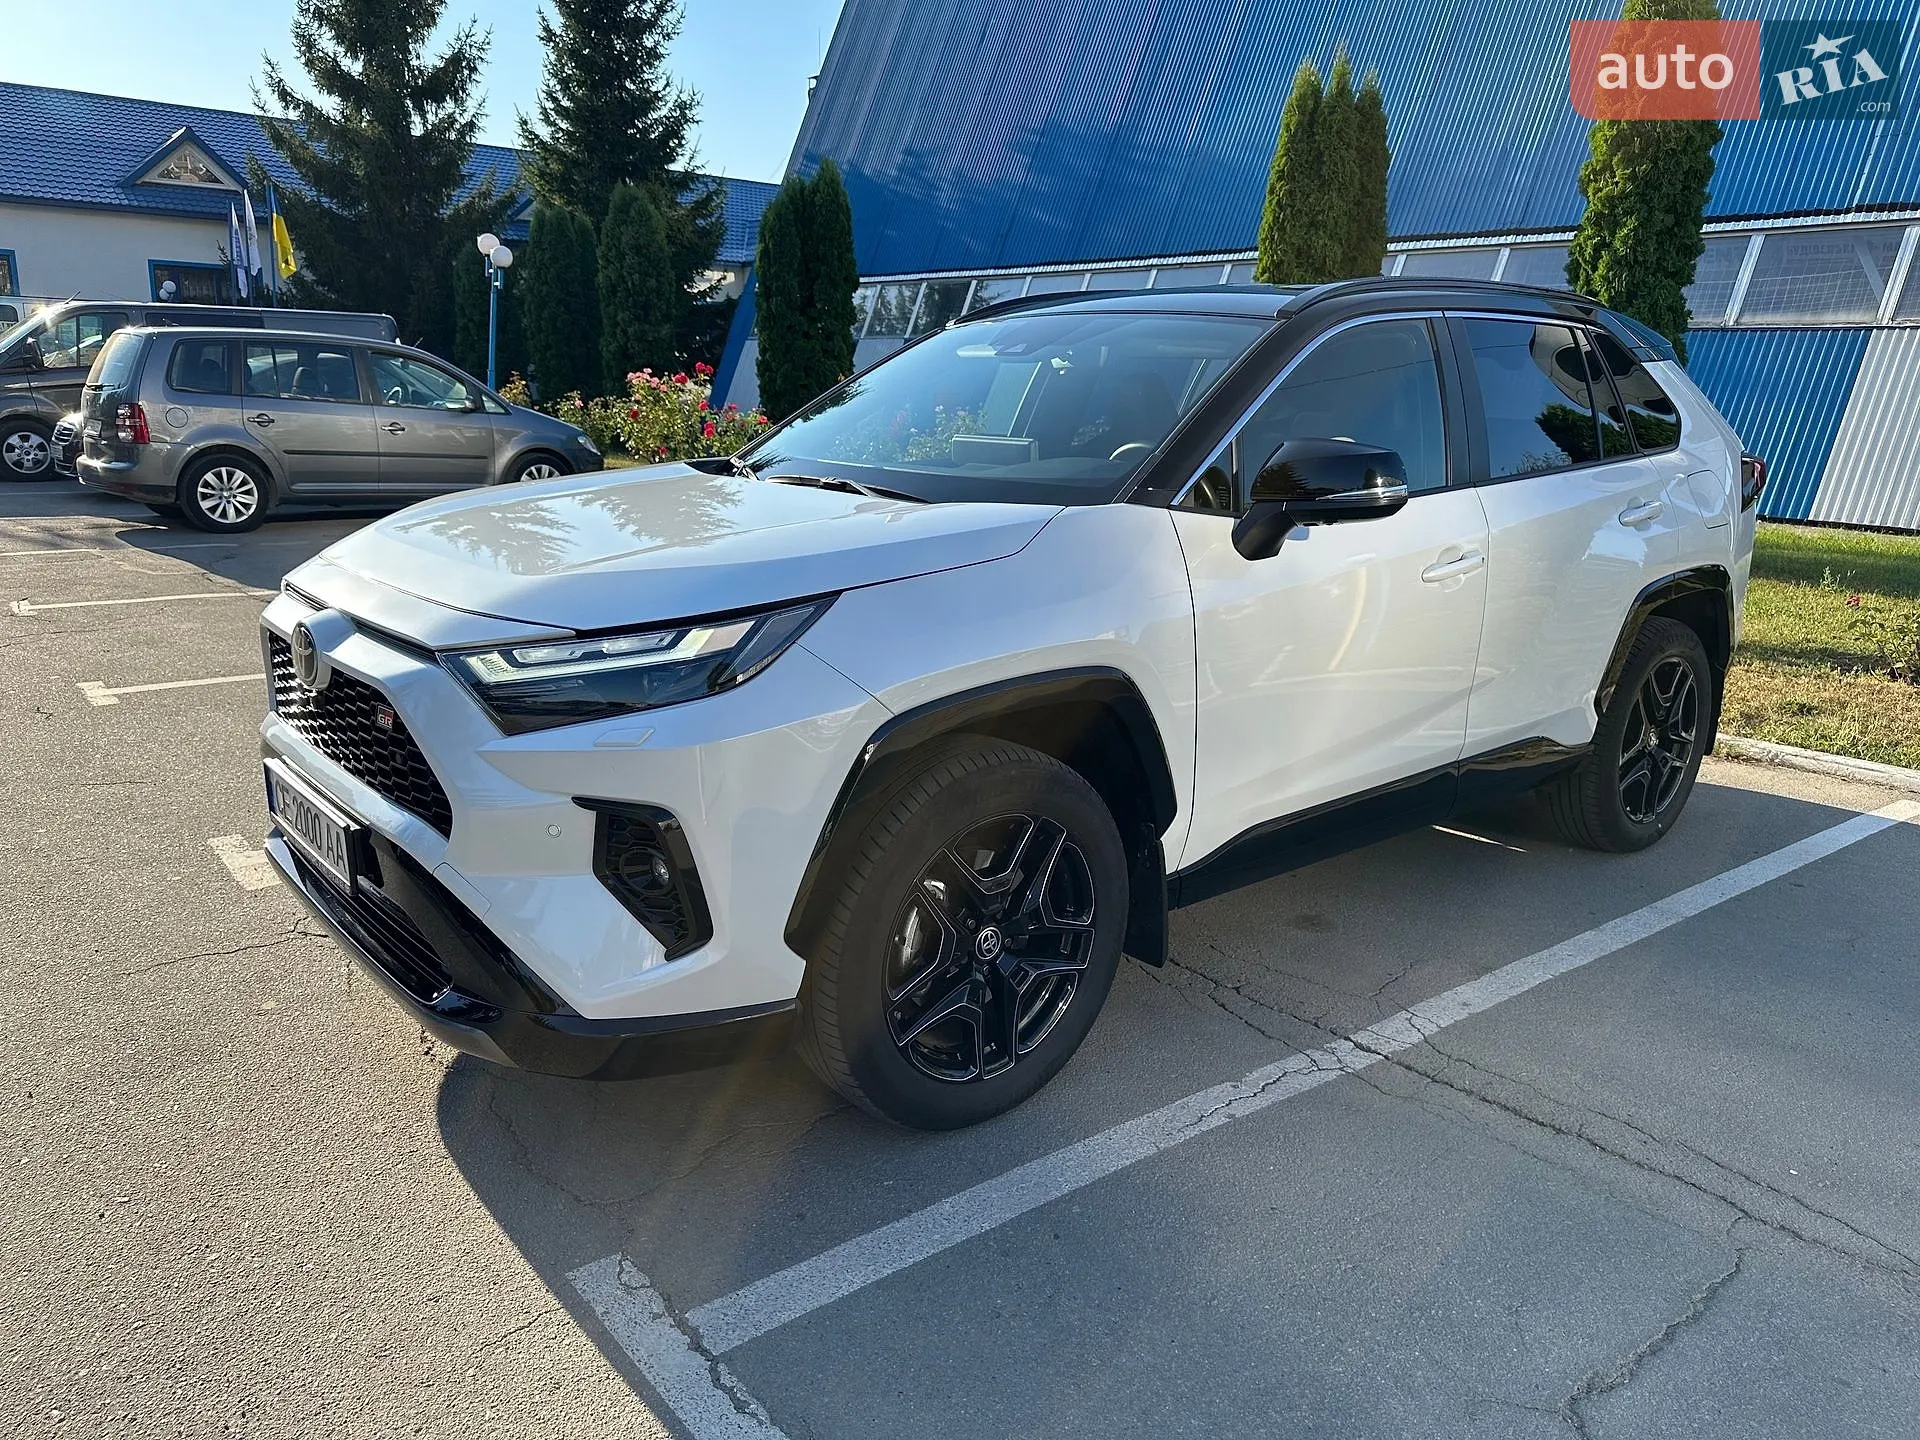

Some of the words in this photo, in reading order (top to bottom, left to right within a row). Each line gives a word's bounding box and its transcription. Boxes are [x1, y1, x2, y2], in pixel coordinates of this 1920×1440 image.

[378, 714, 393, 728] GR
[292, 795, 322, 852] 2000
[326, 822, 348, 875] AA
